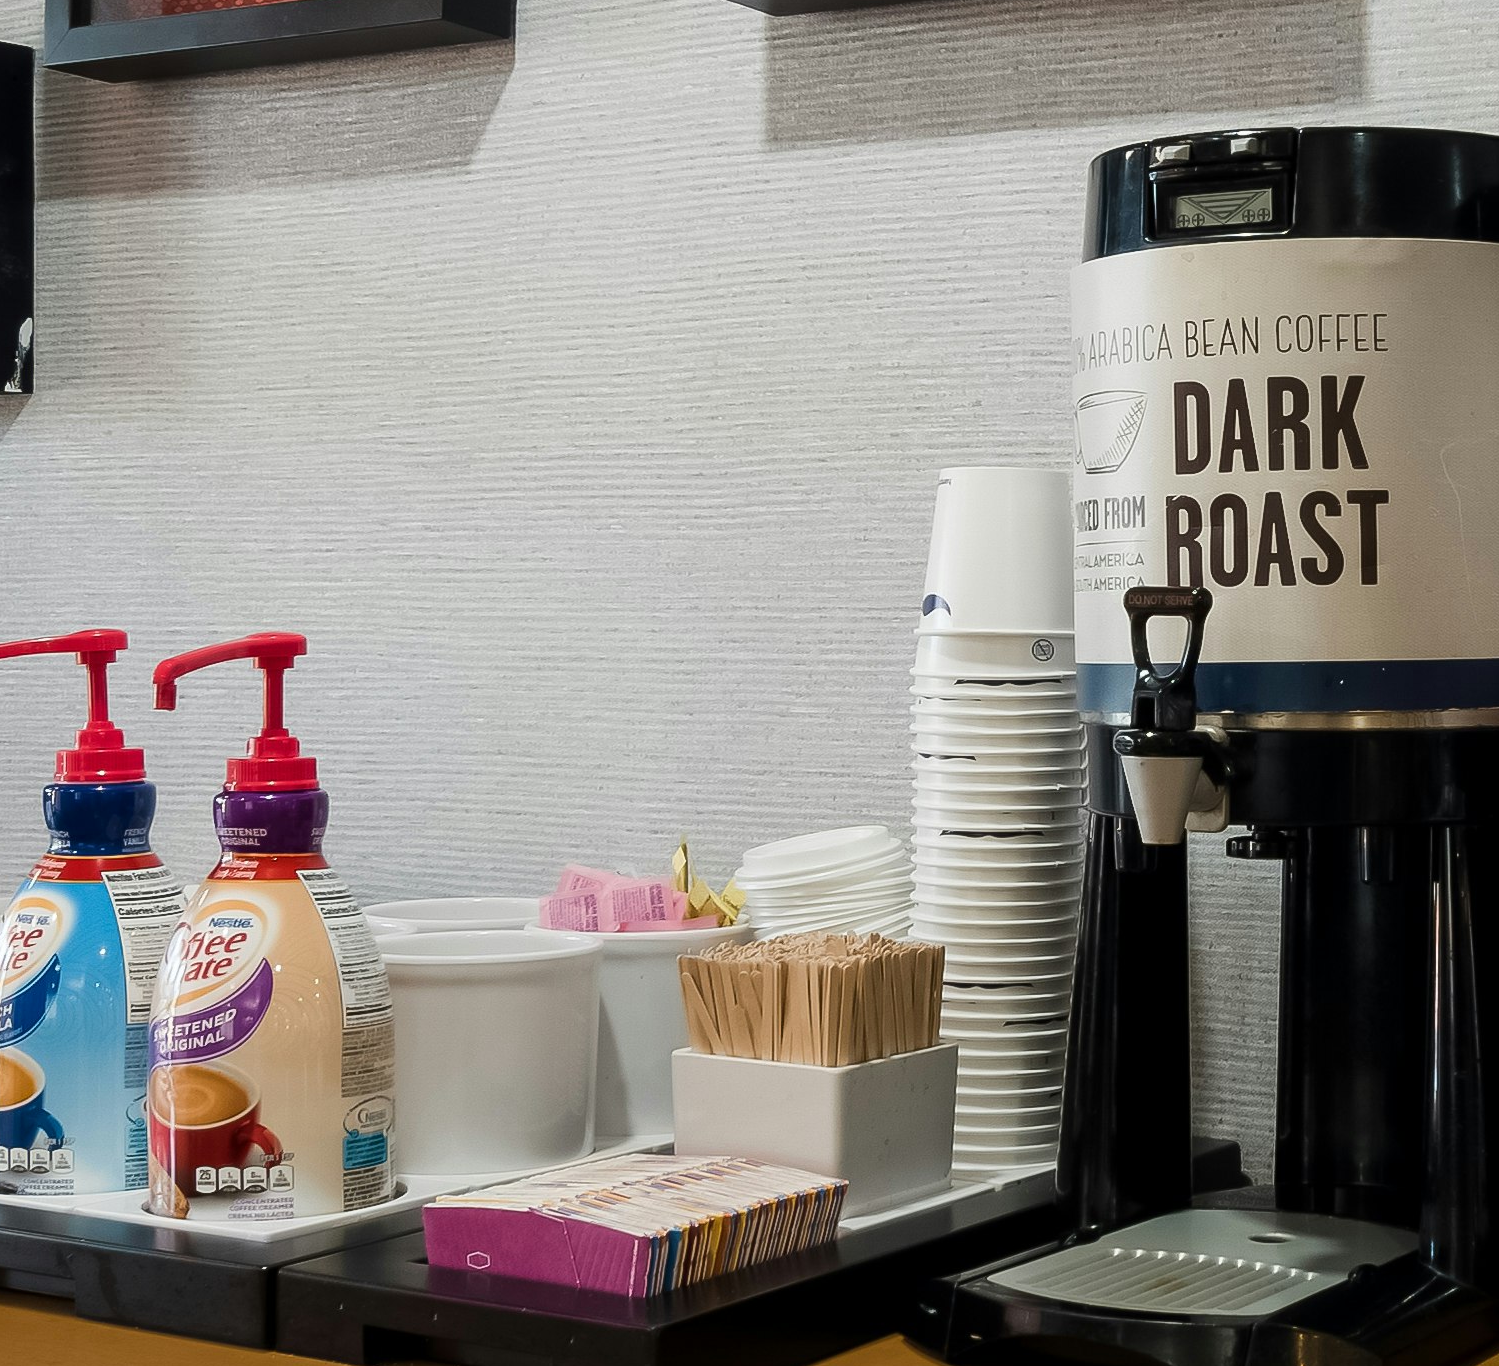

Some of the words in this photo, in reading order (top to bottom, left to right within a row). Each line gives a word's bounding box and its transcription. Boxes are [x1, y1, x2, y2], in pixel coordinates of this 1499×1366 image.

[1088, 323, 1173, 371] ARABICA
[1185, 316, 1261, 358] BEAN
[1275, 313, 1390, 353] COFFEE
[1172, 375, 1370, 476] DARK
[1104, 495, 1146, 530] FROM
[1165, 490, 1390, 588] ROAST
[1128, 595, 1142, 605] DO
[1144, 595, 1162, 605] NOT
[1165, 595, 1193, 606] SERVE
[199, 1169, 212, 1181] 25
